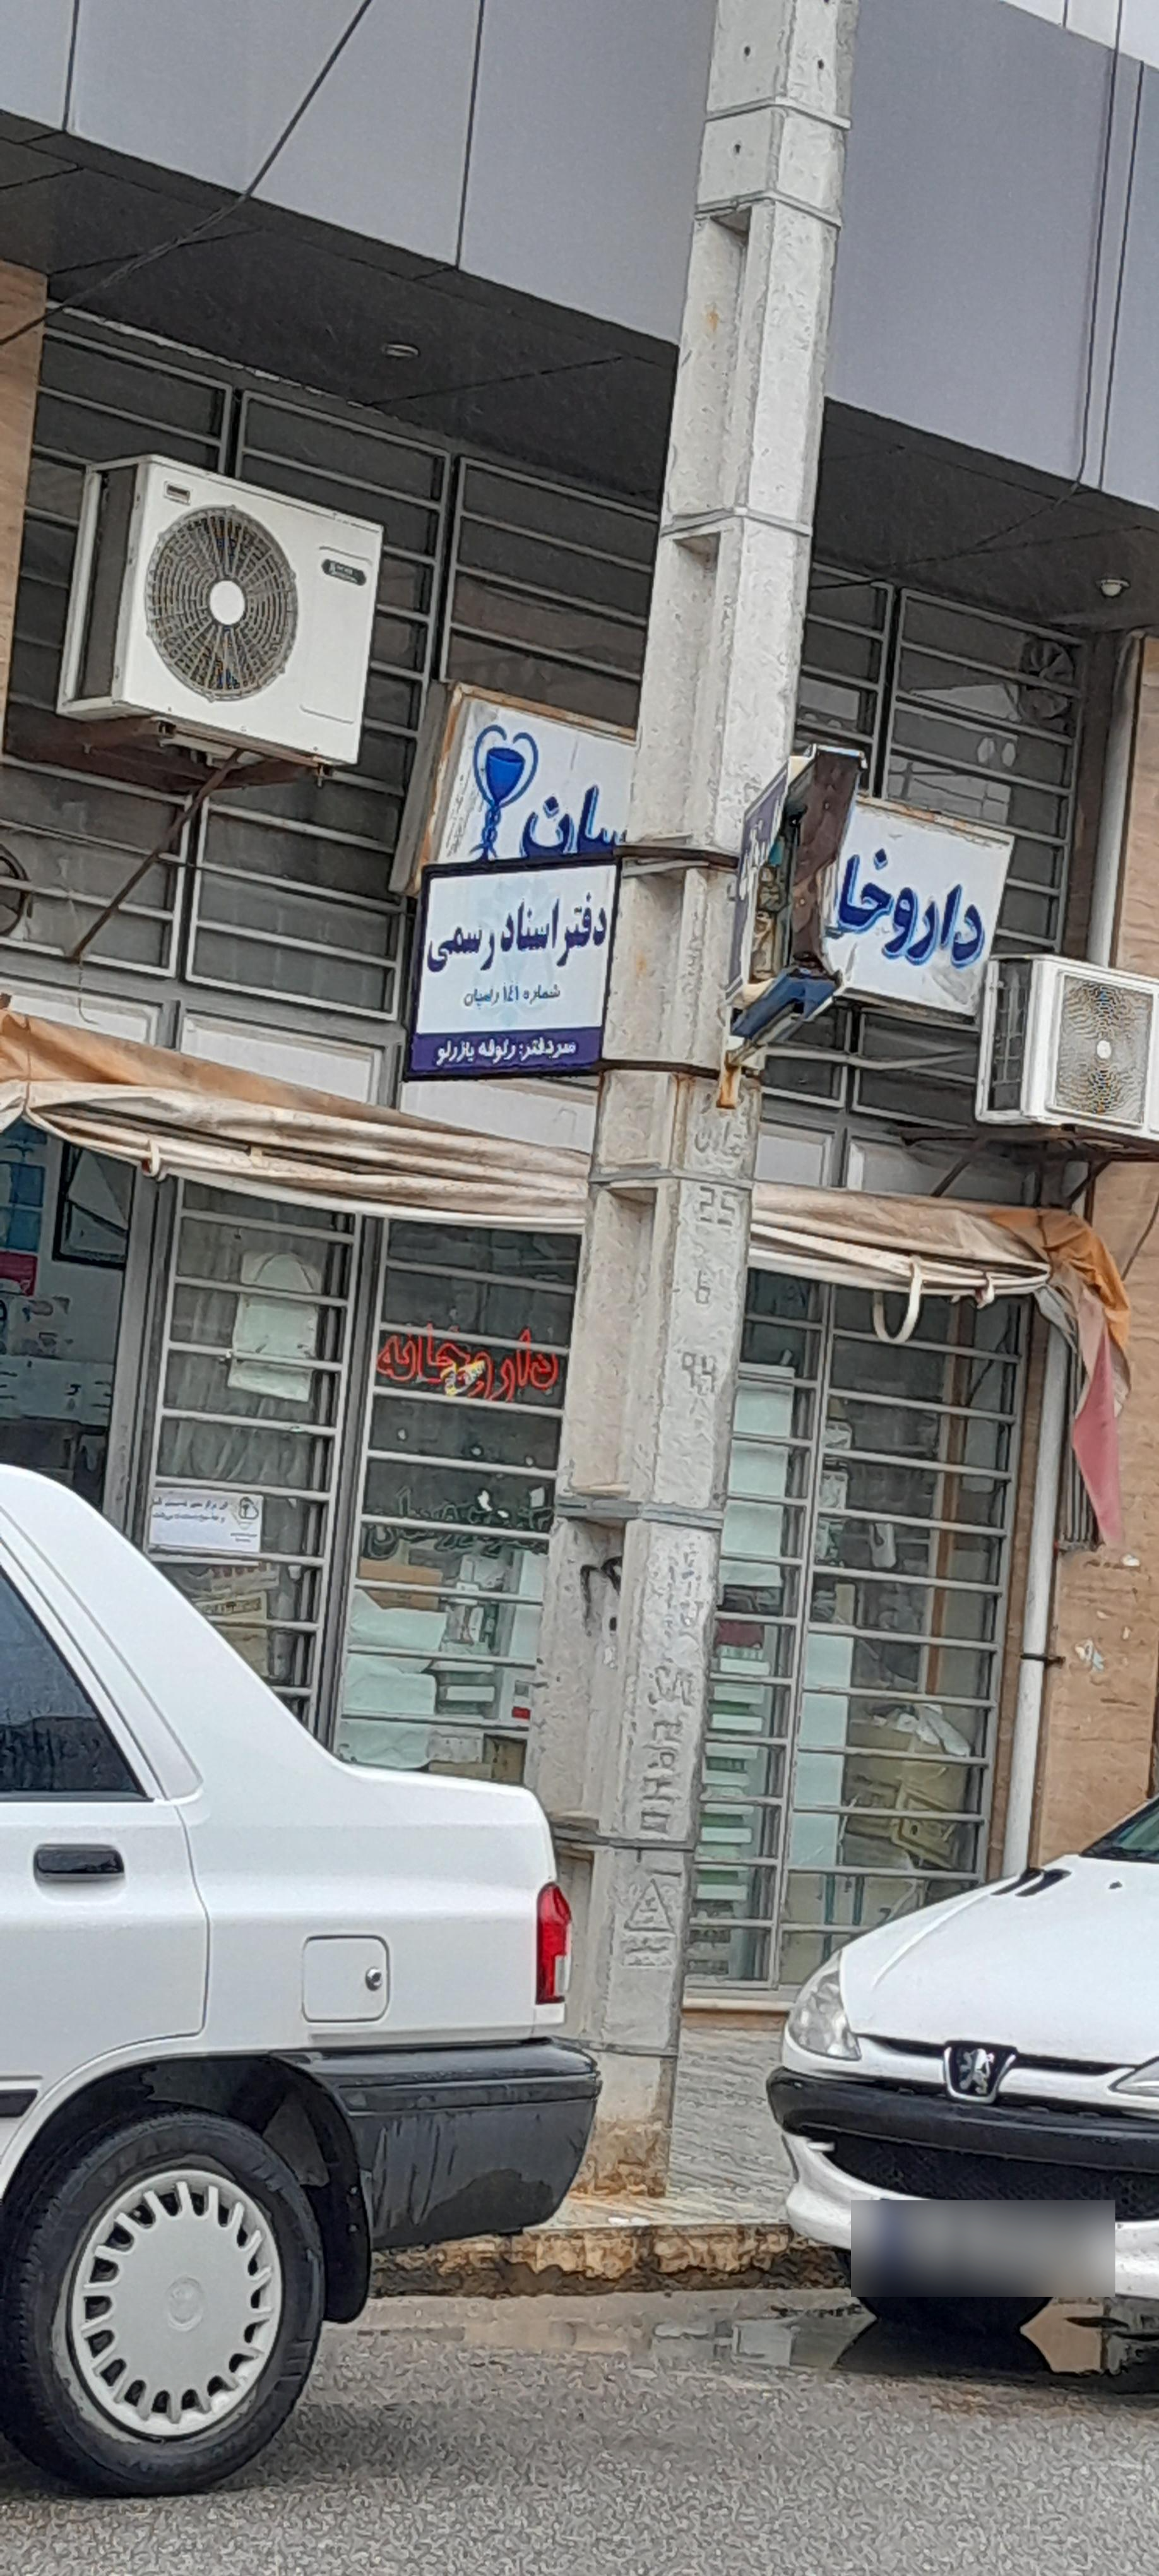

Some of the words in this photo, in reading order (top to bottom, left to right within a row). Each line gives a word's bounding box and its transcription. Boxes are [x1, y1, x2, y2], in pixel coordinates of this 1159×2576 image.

[500, 897, 560, 953] اسناد
[556, 891, 607, 967] دفتر
[837, 849, 986, 969] داروخا
[427, 926, 495, 973] رسمی
[523, 983, 561, 1005] شماره
